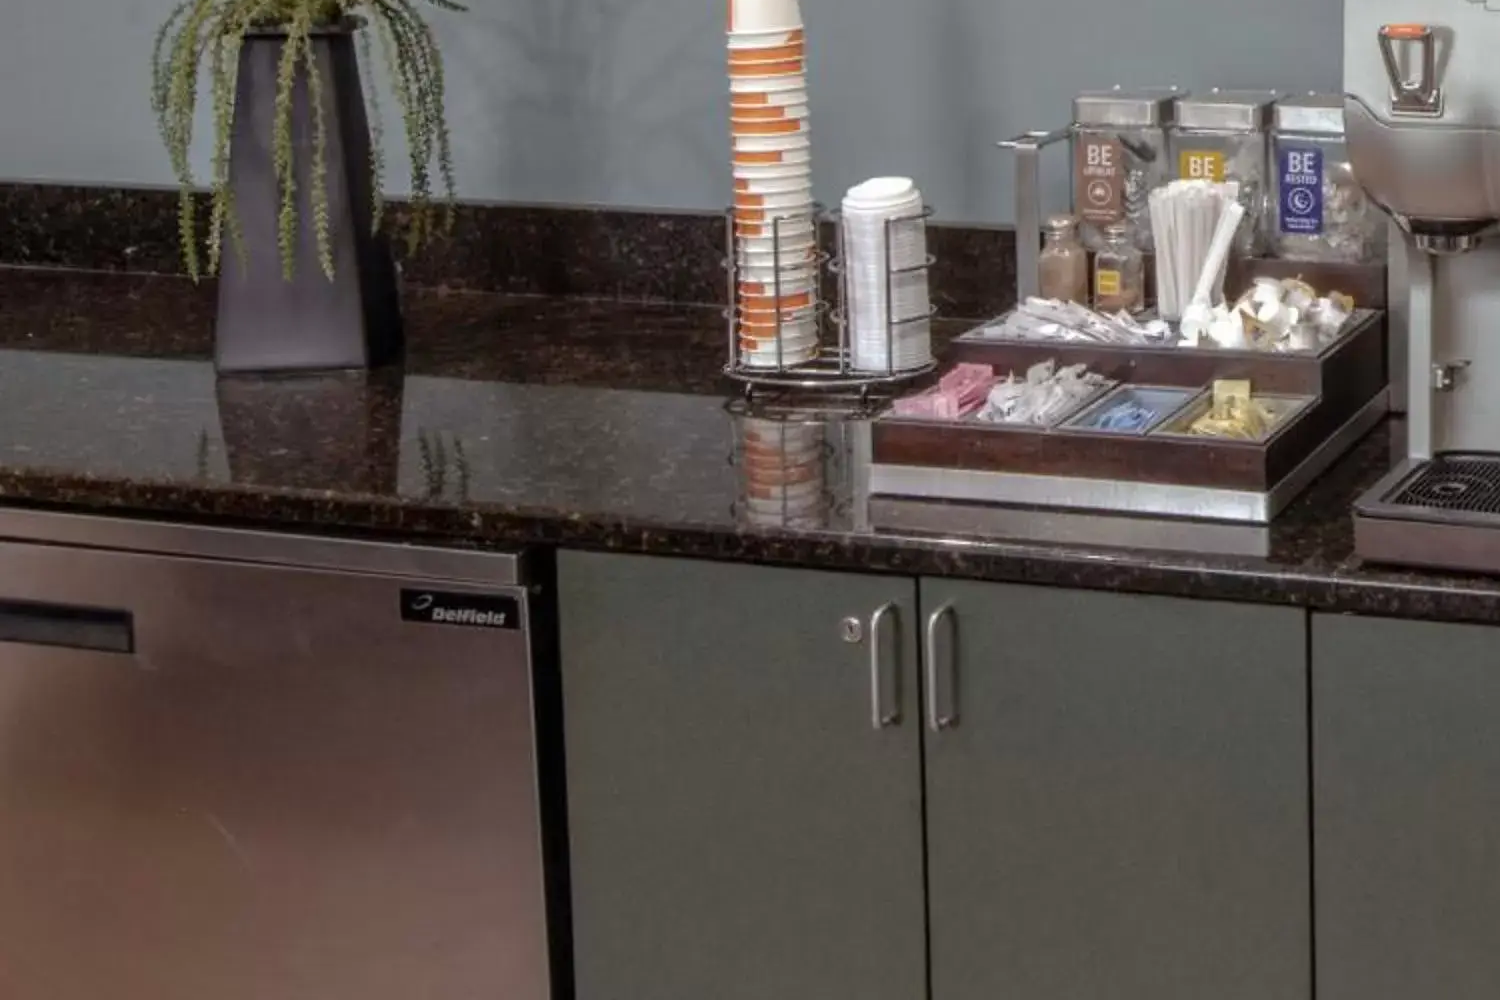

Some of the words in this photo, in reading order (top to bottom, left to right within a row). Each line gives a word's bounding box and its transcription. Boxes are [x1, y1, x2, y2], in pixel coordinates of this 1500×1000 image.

[1087, 144, 1113, 166] BE
[1288, 151, 1314, 173] BE
[1189, 156, 1215, 177] BE
[432, 607, 505, 625] Delfield
